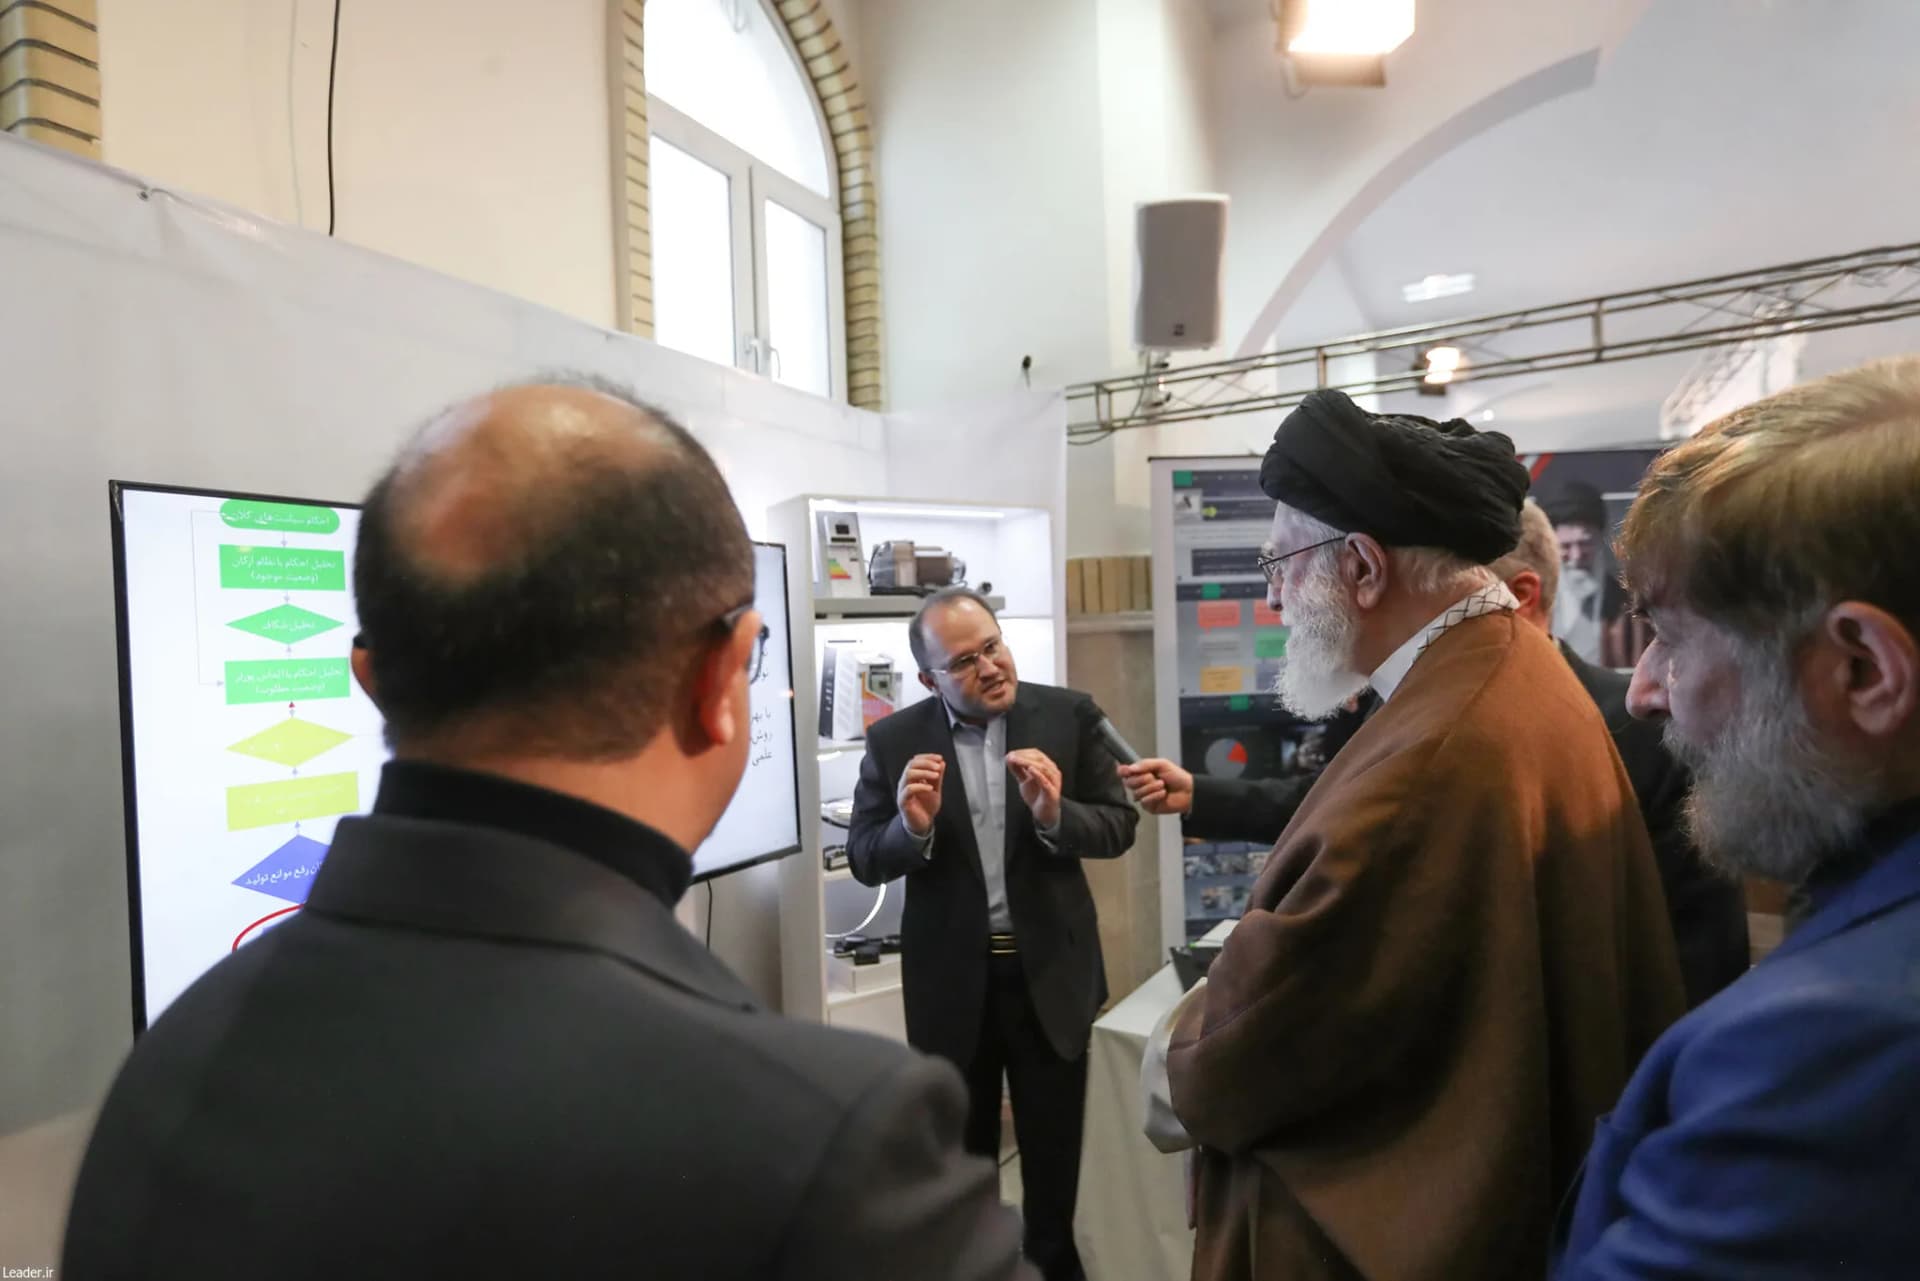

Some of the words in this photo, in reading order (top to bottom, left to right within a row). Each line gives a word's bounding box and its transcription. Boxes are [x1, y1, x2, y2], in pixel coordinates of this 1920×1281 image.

[244, 872, 269, 886] تولید
[269, 868, 293, 884] موانع
[293, 864, 309, 879] رفع
